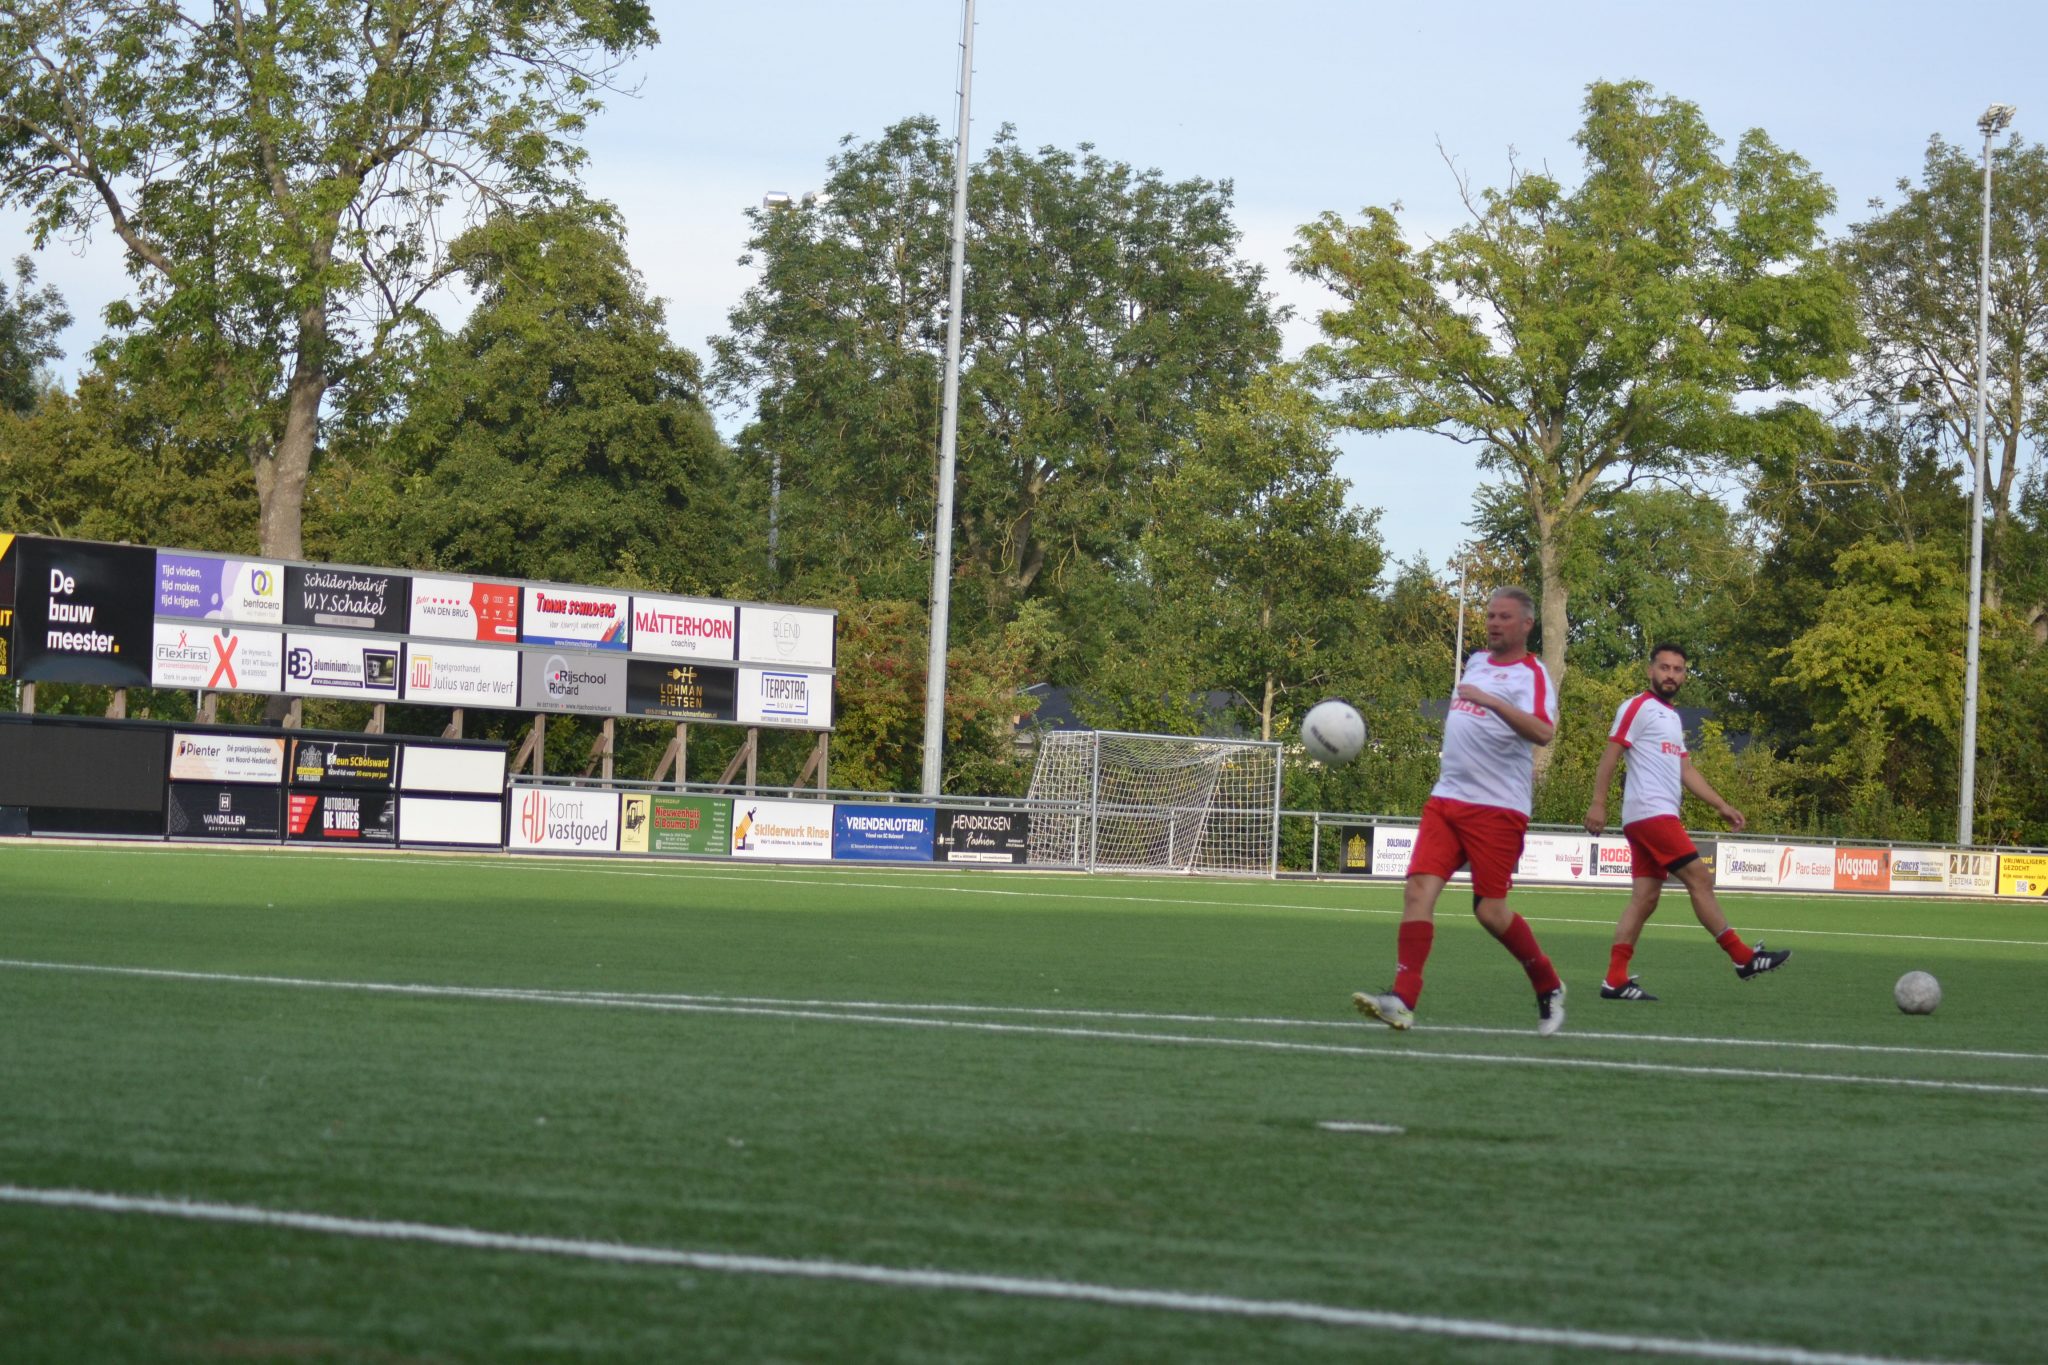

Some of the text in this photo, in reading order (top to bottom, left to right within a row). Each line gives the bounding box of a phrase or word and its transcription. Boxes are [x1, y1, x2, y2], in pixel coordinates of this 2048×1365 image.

[162, 565, 202, 578] Tijd vinden,
[51, 569, 75, 594] De
[162, 581, 202, 593] tijd maken,
[303, 573, 388, 597] Schildersbedrijf
[161, 595, 201, 608] tijd krijgen.
[243, 598, 280, 610] bentacera
[537, 592, 617, 619] TIMME SCHILDERS
[48, 597, 95, 624] bouw
[422, 606, 469, 618] VAN DEN BRUG
[635, 608, 732, 639] MATTERHORN
[773, 621, 801, 639] BLEND
[47, 630, 120, 653] meester.
[671, 639, 696, 650] coaching
[158, 647, 208, 660] FlexFirst
[434, 662, 481, 673] Tegelgroothandel
[560, 670, 607, 684] Rijschool
[433, 677, 514, 694] Julius van der Werf
[549, 682, 579, 695] Richard
[661, 683, 703, 697] LOHMAN
[765, 678, 806, 700] TERPSTRA
[661, 696, 703, 708] FIETSEN
[186, 743, 221, 757] Pienter
[324, 796, 360, 811] AUTOBEDRIJF
[549, 796, 583, 820] komt
[203, 814, 246, 826] VANDILLEN
[324, 811, 334, 829] DE
[336, 811, 360, 830] VRIES
[661, 818, 687, 829] Bouma
[846, 816, 924, 833] VRIENDENLOTERIJ
[953, 814, 1011, 831] HENDRIKSEN
[548, 819, 608, 845] vastgoed
[754, 823, 830, 839] Skilderwurk Rinse
[966, 831, 996, 848] Fashion
[1386, 838, 1412, 848] BOLSWARD
[1796, 861, 1831, 876] Parc Estate
[1837, 852, 1879, 881] vlagsma
[2003, 857, 2047, 866] VRIJWILLIGERS
